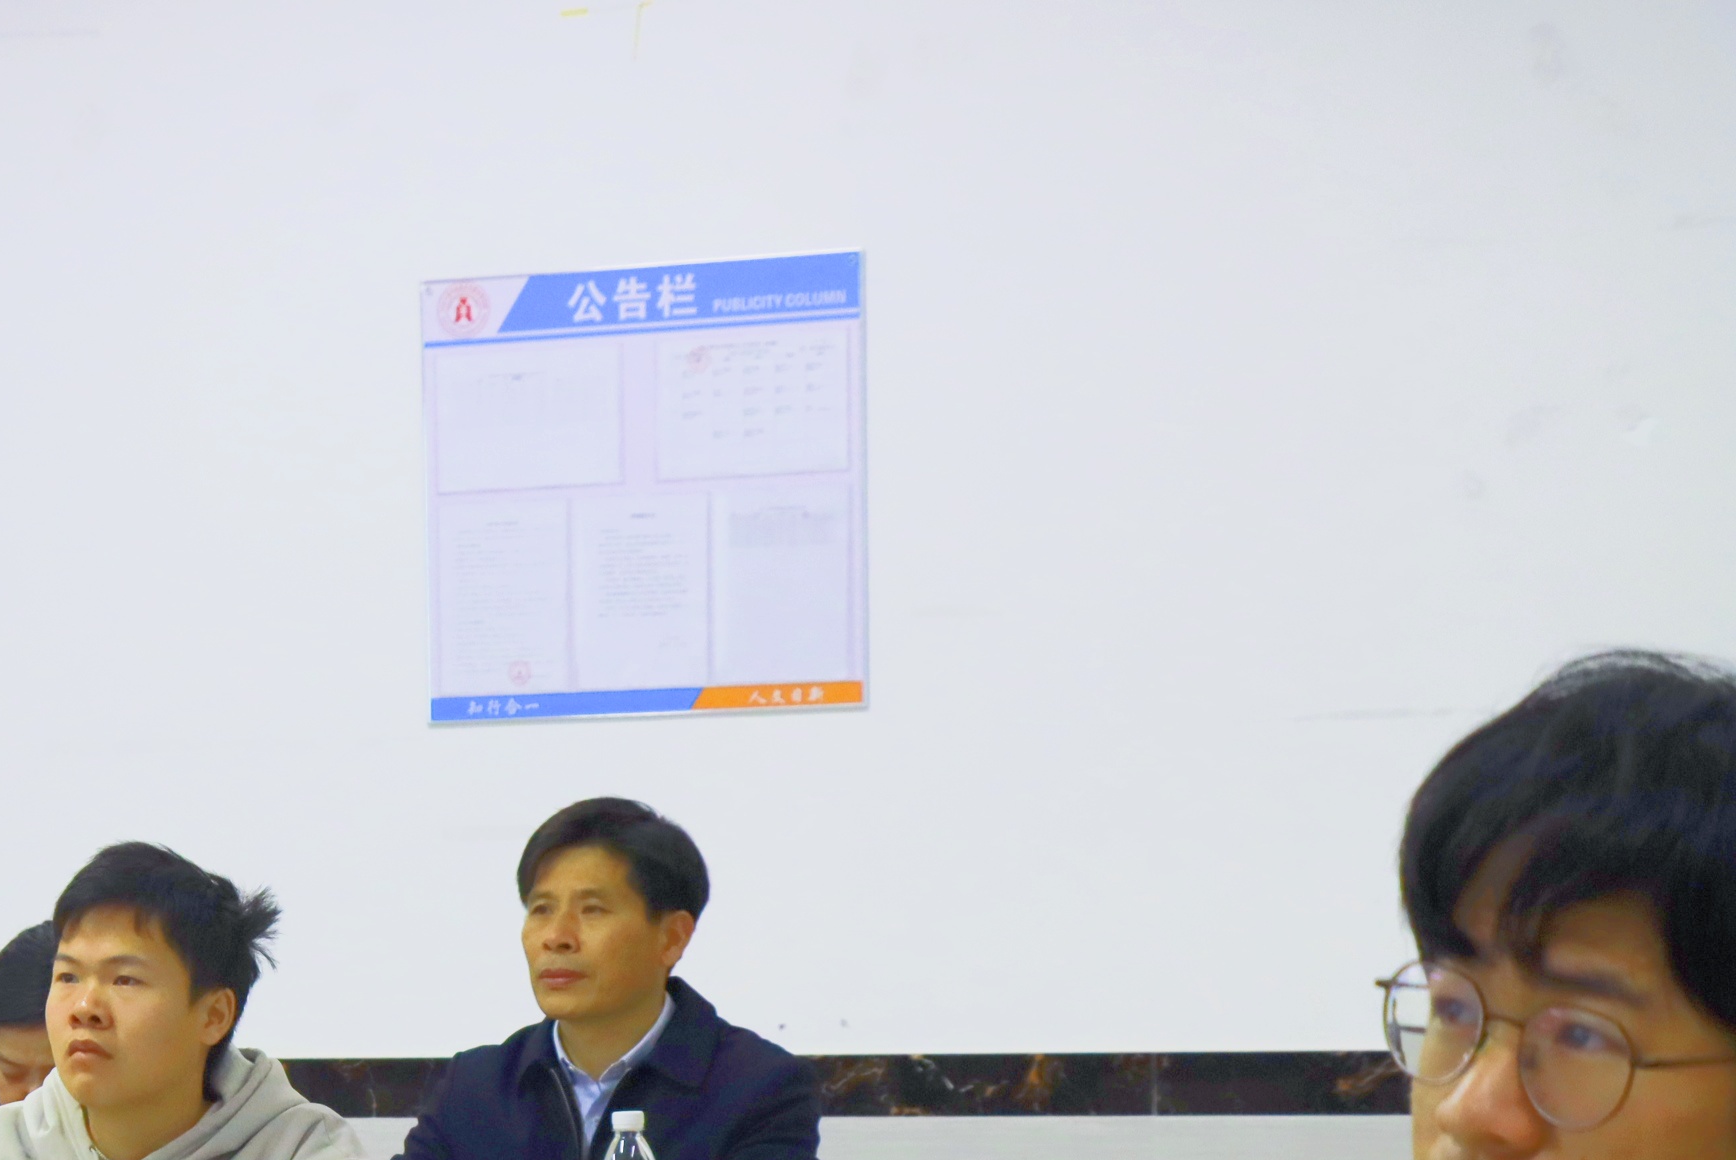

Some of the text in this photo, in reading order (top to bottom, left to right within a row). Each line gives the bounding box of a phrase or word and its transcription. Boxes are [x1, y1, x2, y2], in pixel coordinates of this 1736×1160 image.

[568, 273, 697, 322] 公告栏
[713, 290, 847, 313] PUBLICITY COLUMN
